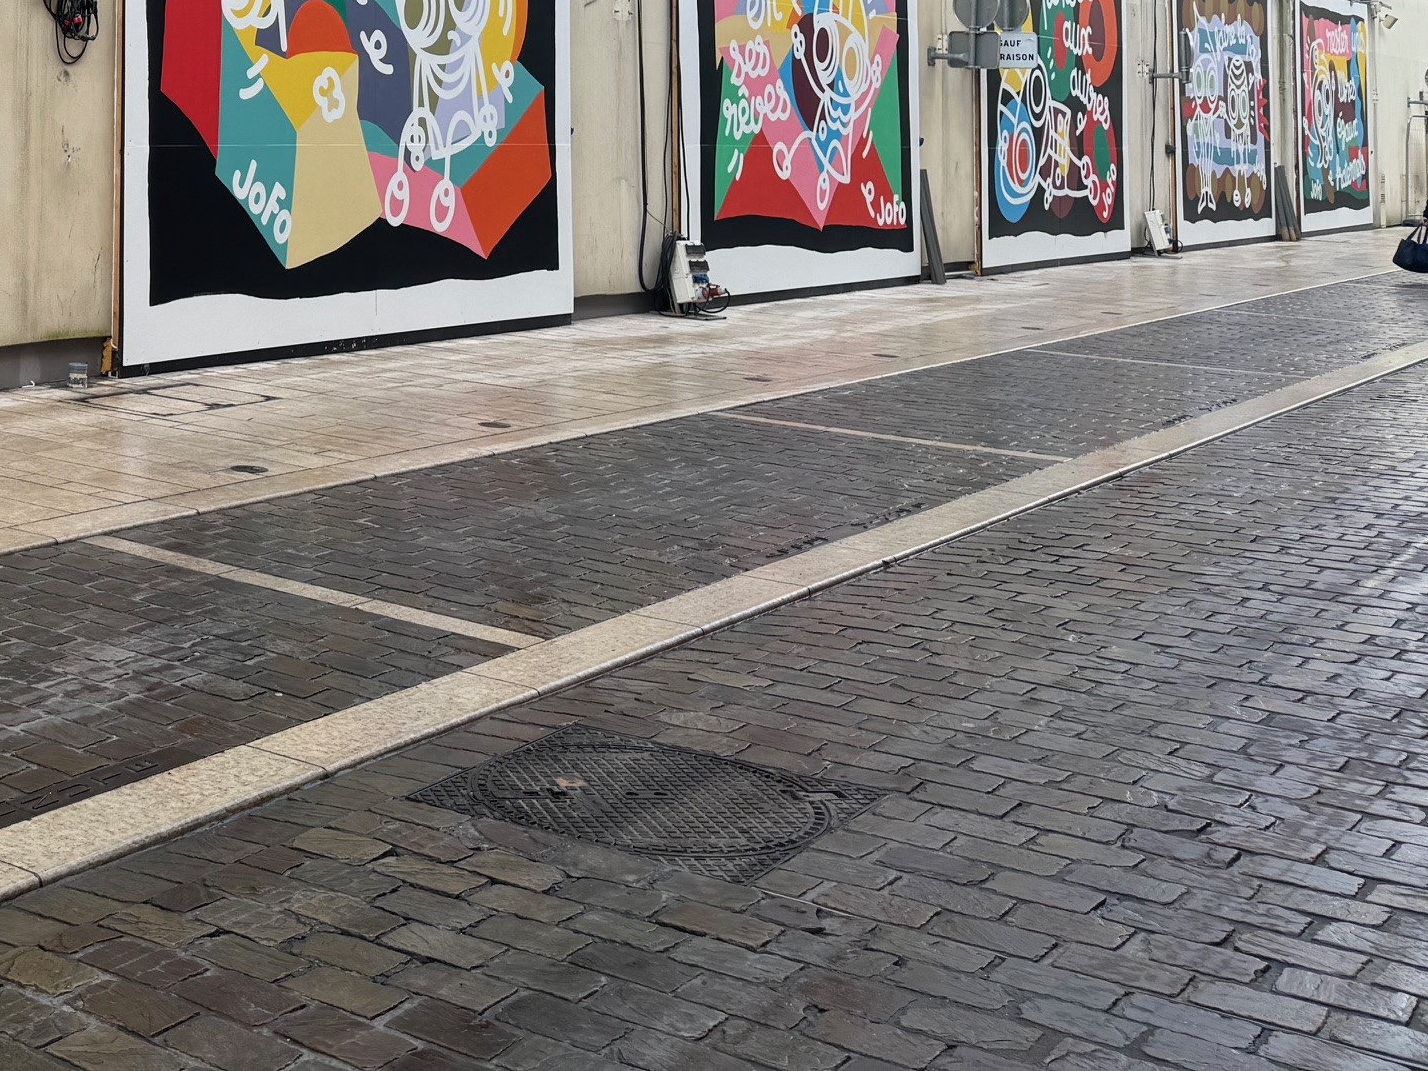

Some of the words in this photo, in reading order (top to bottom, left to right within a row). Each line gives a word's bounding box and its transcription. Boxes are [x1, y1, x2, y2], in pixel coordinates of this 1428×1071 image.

[730, 35, 770, 86] ses
[1062, 18, 1093, 56] aux
[723, 77, 791, 140] rêves
[1070, 63, 1111, 130] autres
[233, 159, 292, 244] JoFo
